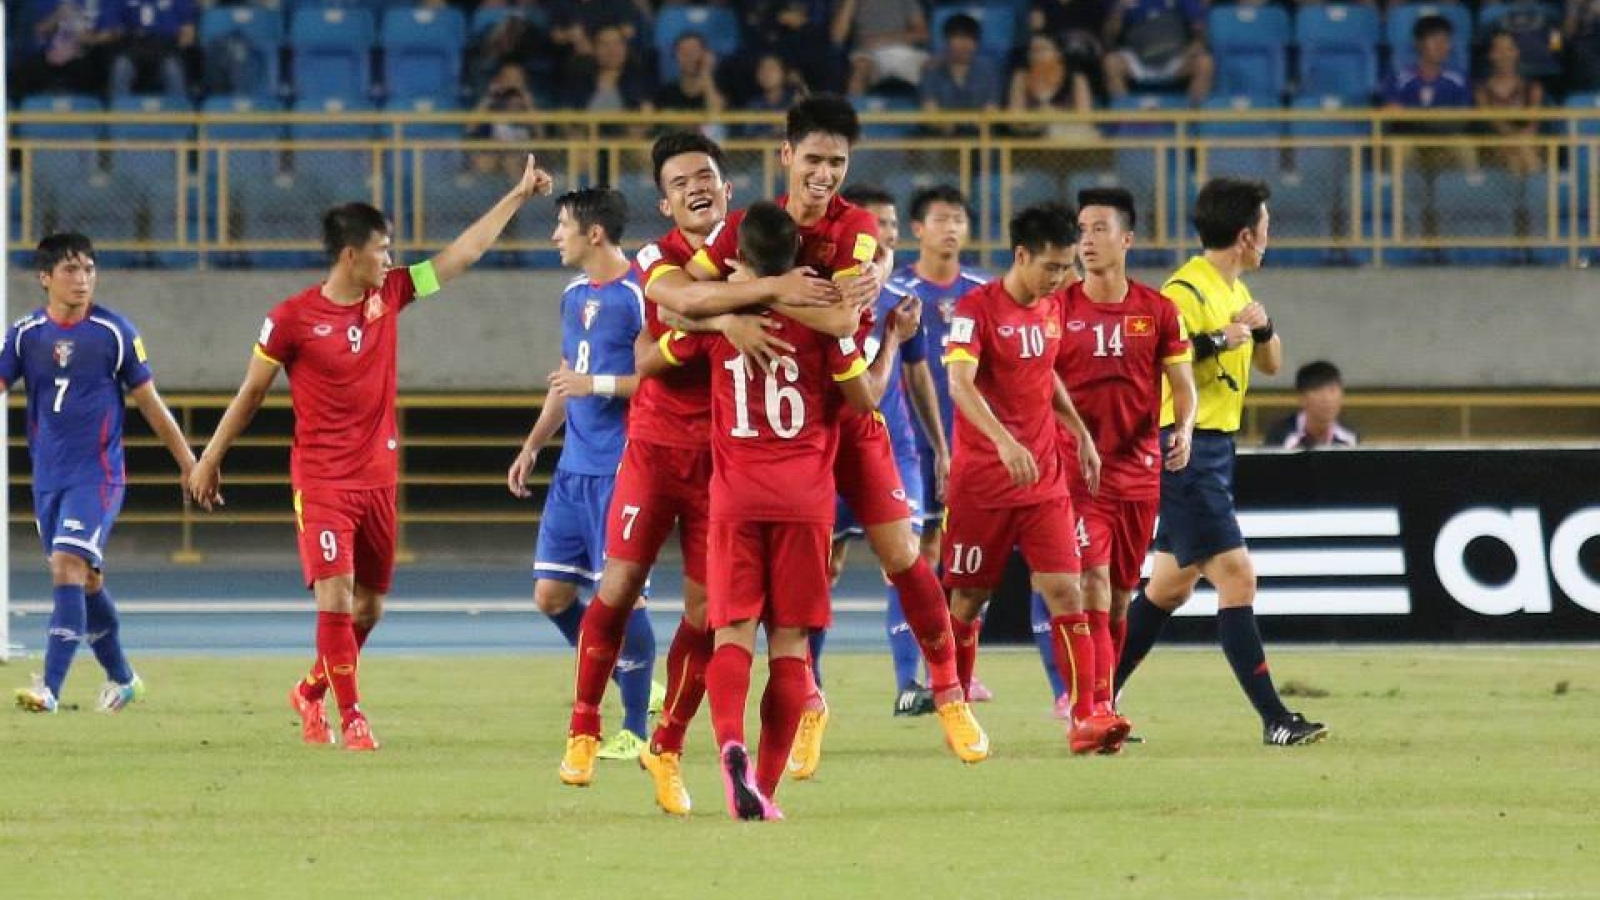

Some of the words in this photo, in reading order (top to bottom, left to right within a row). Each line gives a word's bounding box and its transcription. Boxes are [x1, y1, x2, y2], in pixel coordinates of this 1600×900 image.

[347, 325, 362, 353] 9
[1017, 325, 1044, 358] 10
[1092, 323, 1123, 357] 14
[575, 340, 589, 374] 8
[53, 378, 70, 412] 7
[724, 353, 806, 439] 16
[621, 504, 641, 541] 7
[319, 530, 337, 562] 9
[949, 543, 983, 575] 10
